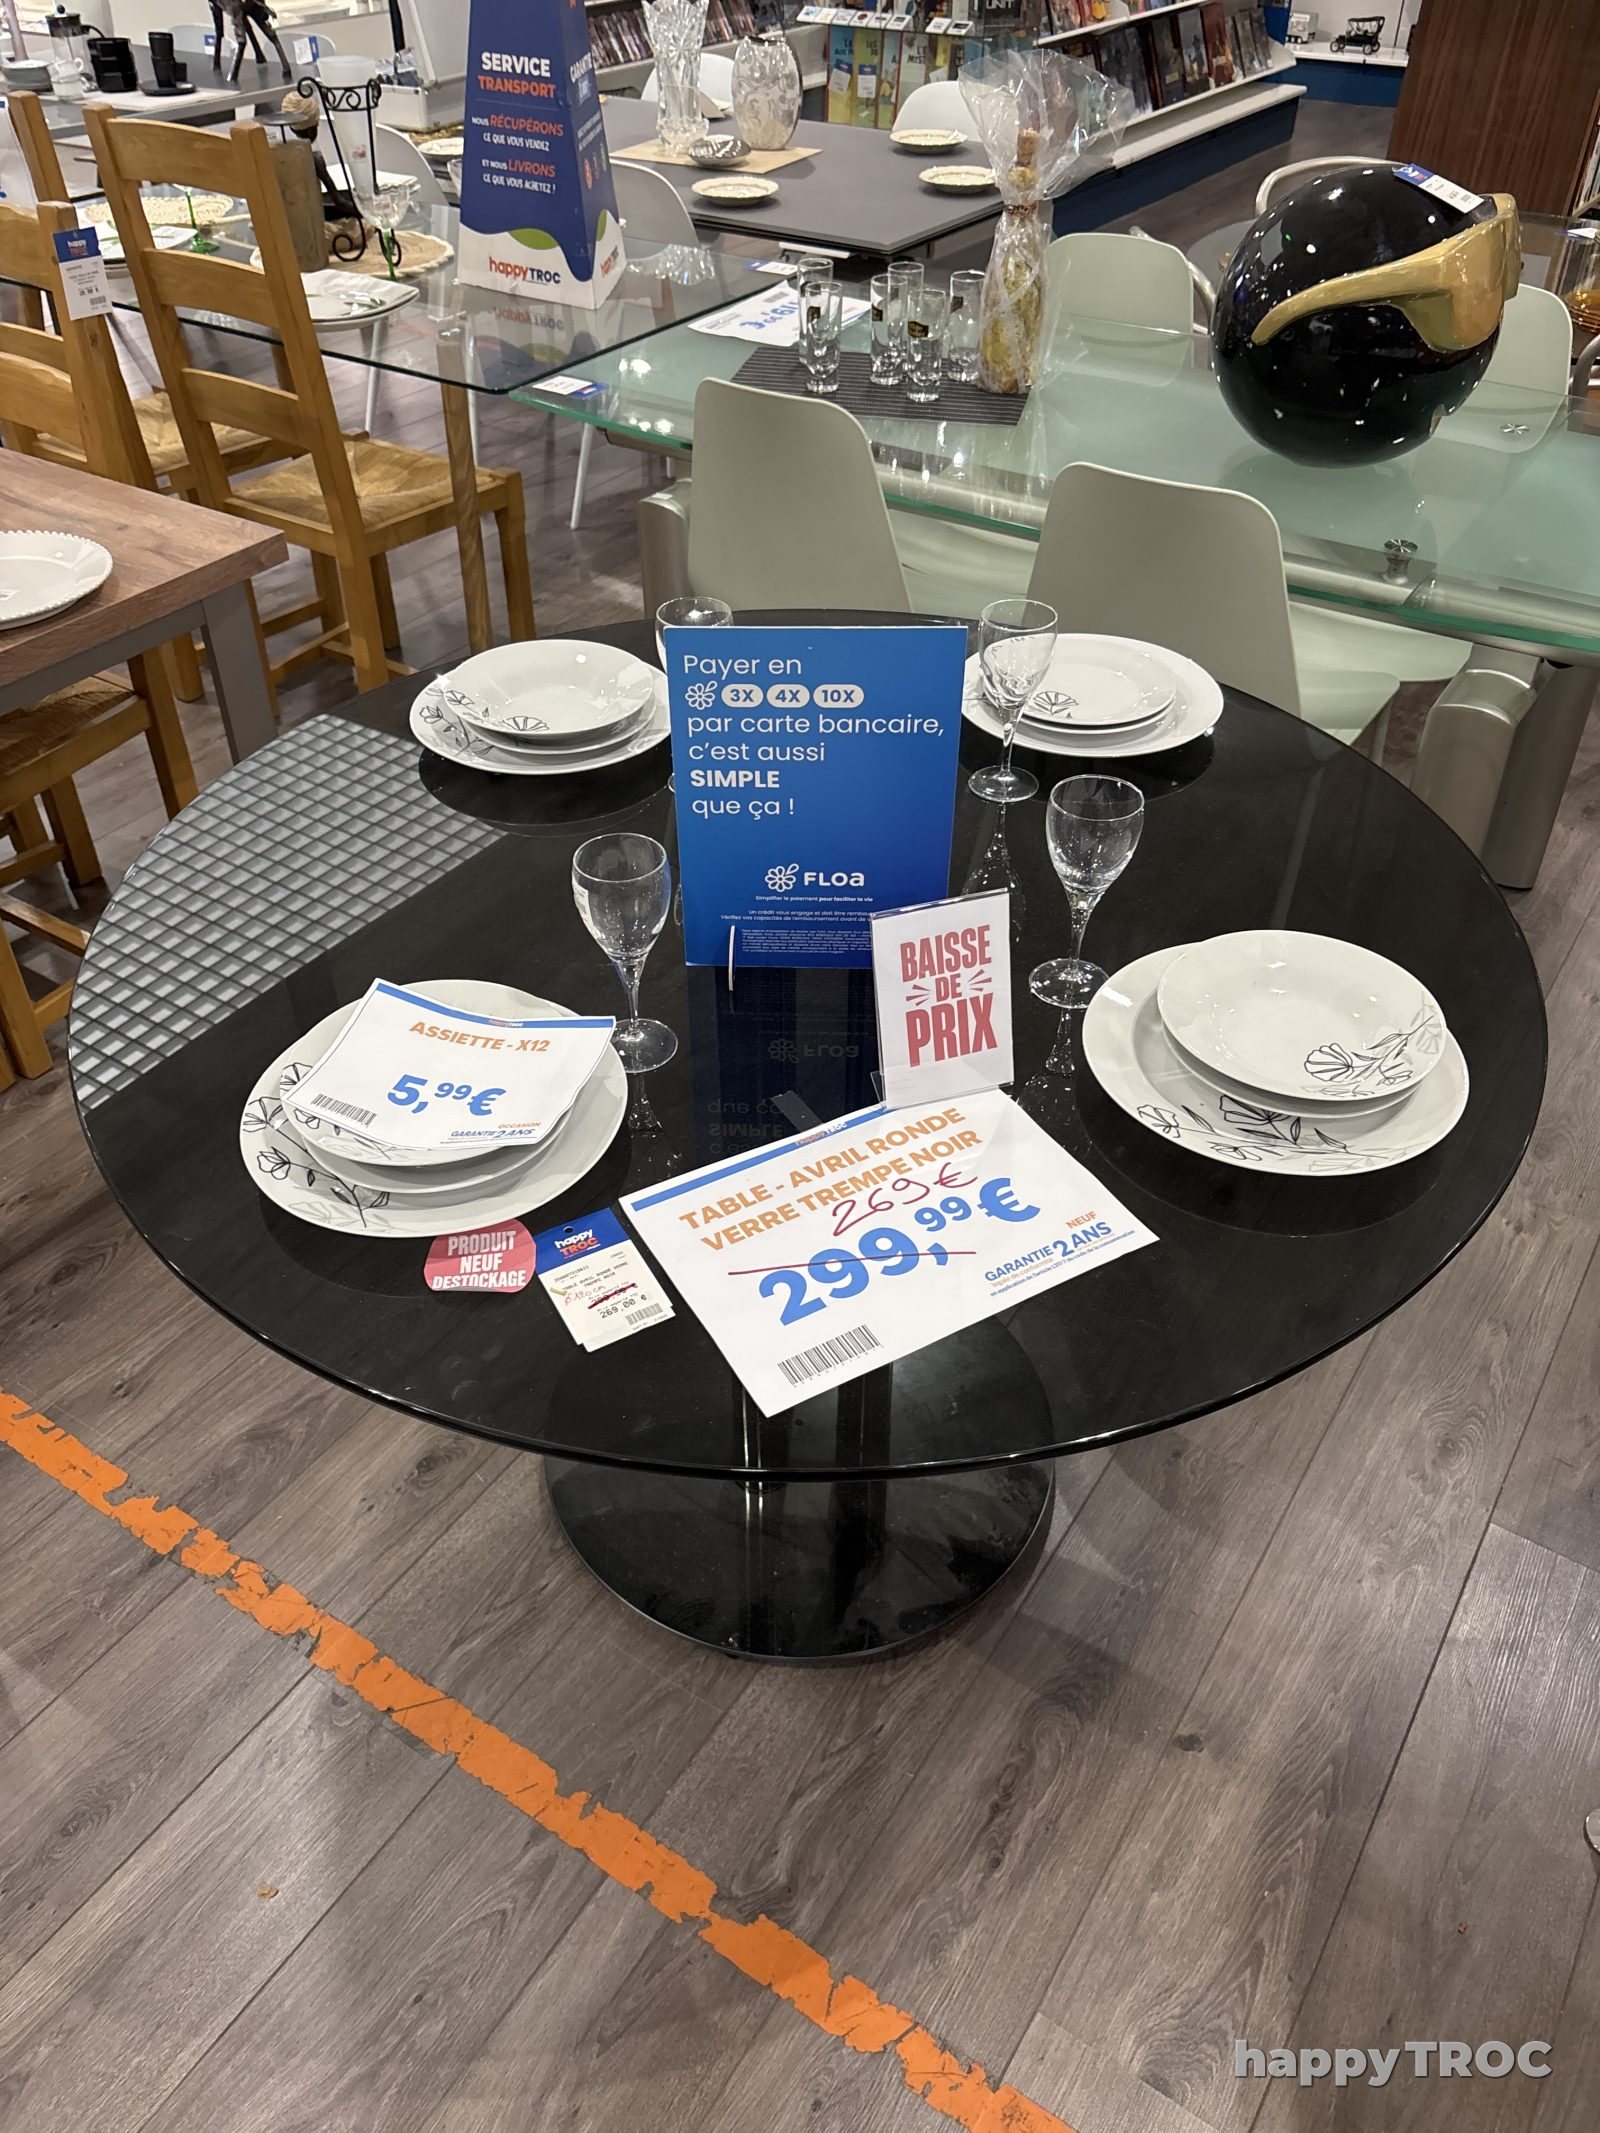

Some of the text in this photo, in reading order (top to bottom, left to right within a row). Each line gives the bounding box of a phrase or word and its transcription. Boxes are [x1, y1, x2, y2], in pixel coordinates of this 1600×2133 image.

[481, 52, 550, 77] SERVICE
[478, 75, 555, 98] TRANSPORT
[472, 116, 489, 127] NOUS
[490, 114, 564, 136] RÉCUPÉRONS
[483, 133, 549, 151] CE QUE VOUS VENDEZ
[482, 159, 555, 178] ET NOUS LIVRONS
[483, 174, 491, 184] CE
[492, 175, 505, 187] QUE
[506, 177, 523, 189] VOUS
[524, 179, 551, 193] ACHETEZ
[488, 257, 561, 284] happyTROC
[684, 655, 802, 680] Payer en
[730, 689, 855, 703] 3X 4X 10X
[688, 713, 944, 737] par carte bancaire,
[689, 743, 826, 761] c'est aussi
[690, 770, 780, 788] SIMPLE
[692, 798, 795, 820] que ça !
[900, 924, 992, 983] BAISSE
[935, 974, 962, 1003] DE
[409, 1021, 505, 1050] ASSIETTE
[516, 1039, 551, 1053] X12
[906, 992, 998, 1068] PRIX
[451, 1130, 496, 1138] GARANTIE
[496, 1130, 508, 1140] 2
[508, 1128, 536, 1137] ANS
[679, 1184, 774, 1231] TABLE
[789, 1147, 869, 1189] AVRIL
[865, 1108, 966, 1155] RONDE
[700, 1130, 983, 1251] VERRE TREMPE NOIR
[1066, 1211, 1097, 1229] NEUF
[447, 1231, 516, 1256] PRODUIT
[554, 1229, 593, 1249] happy
[560, 1237, 598, 1256] TROC
[985, 1245, 1054, 1281] GARANTIE
[1053, 1239, 1075, 1257] 2
[1071, 1222, 1112, 1248] ANS
[460, 1253, 503, 1273] NEUF
[432, 1270, 526, 1289] DESTOCKAGE
[997, 1277, 1026, 1296] application
[1025, 1274, 1033, 1282] de
